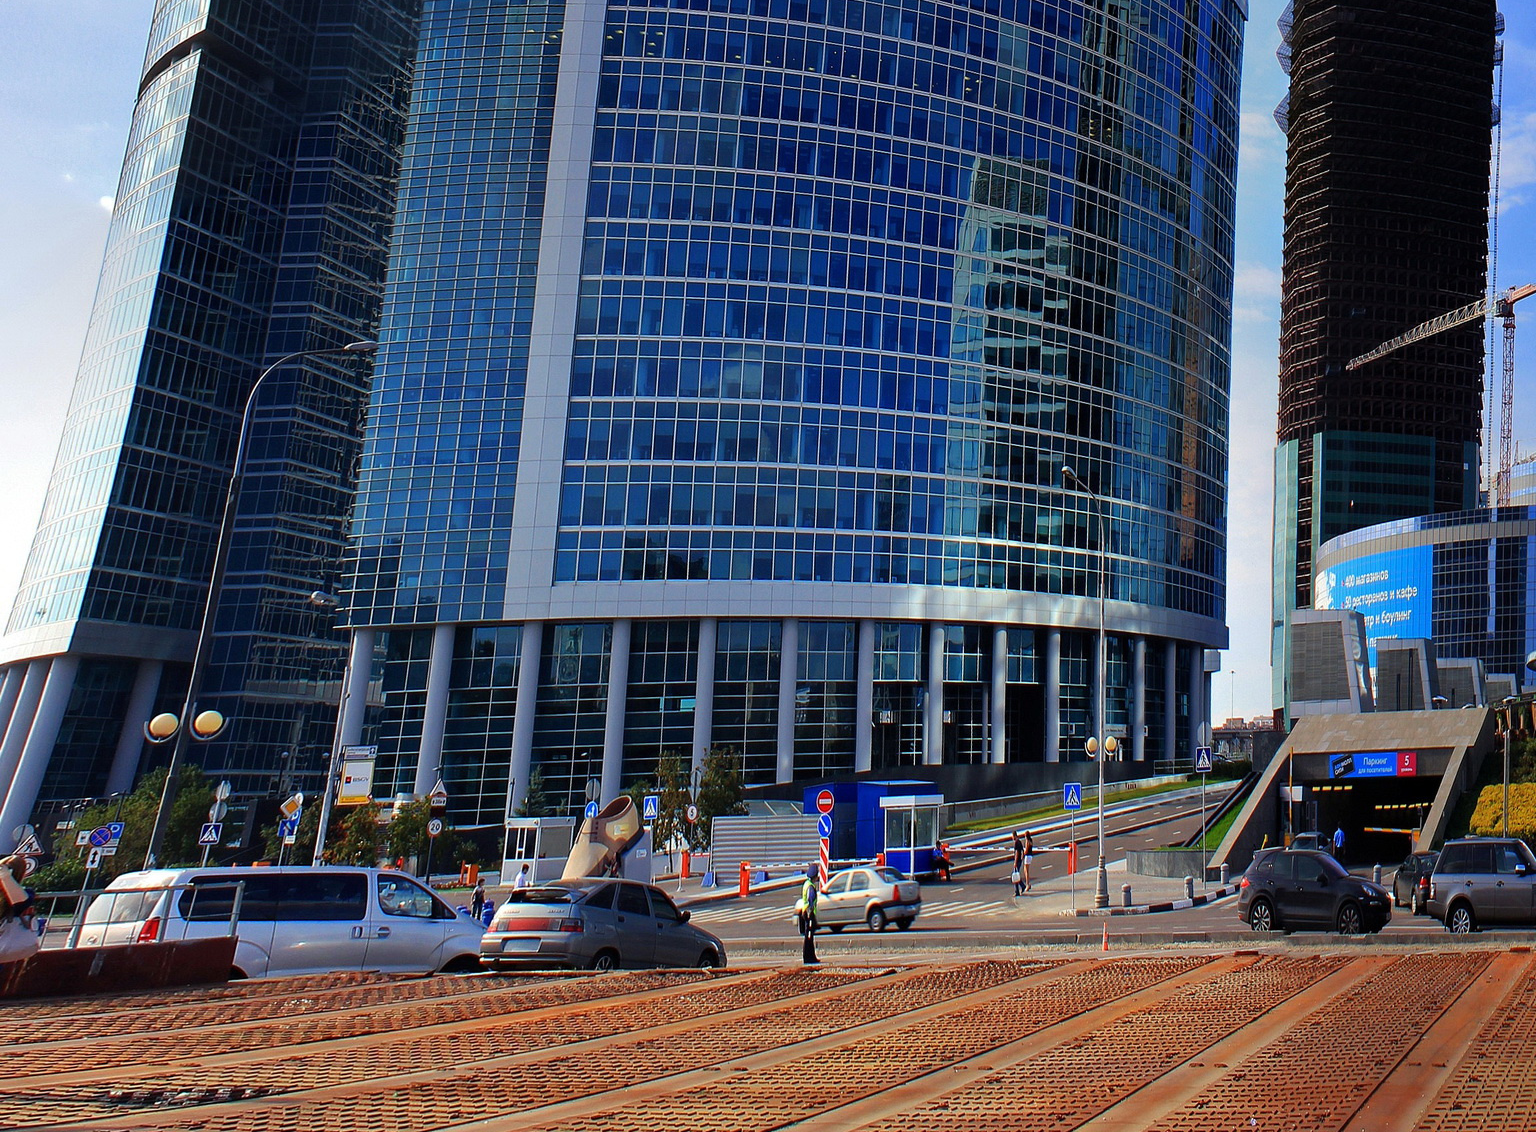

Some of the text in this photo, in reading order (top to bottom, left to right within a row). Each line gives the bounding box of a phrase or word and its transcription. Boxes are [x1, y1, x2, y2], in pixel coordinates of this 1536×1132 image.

[1356, 570, 1389, 585] магазинов
[1352, 590, 1389, 608] ресторанов
[1396, 585, 1418, 601] кафе
[1381, 609, 1412, 627] боулинг
[1363, 757, 1388, 767] Паркинг
[1404, 755, 1410, 766] 5
[430, 823, 440, 831] 20
